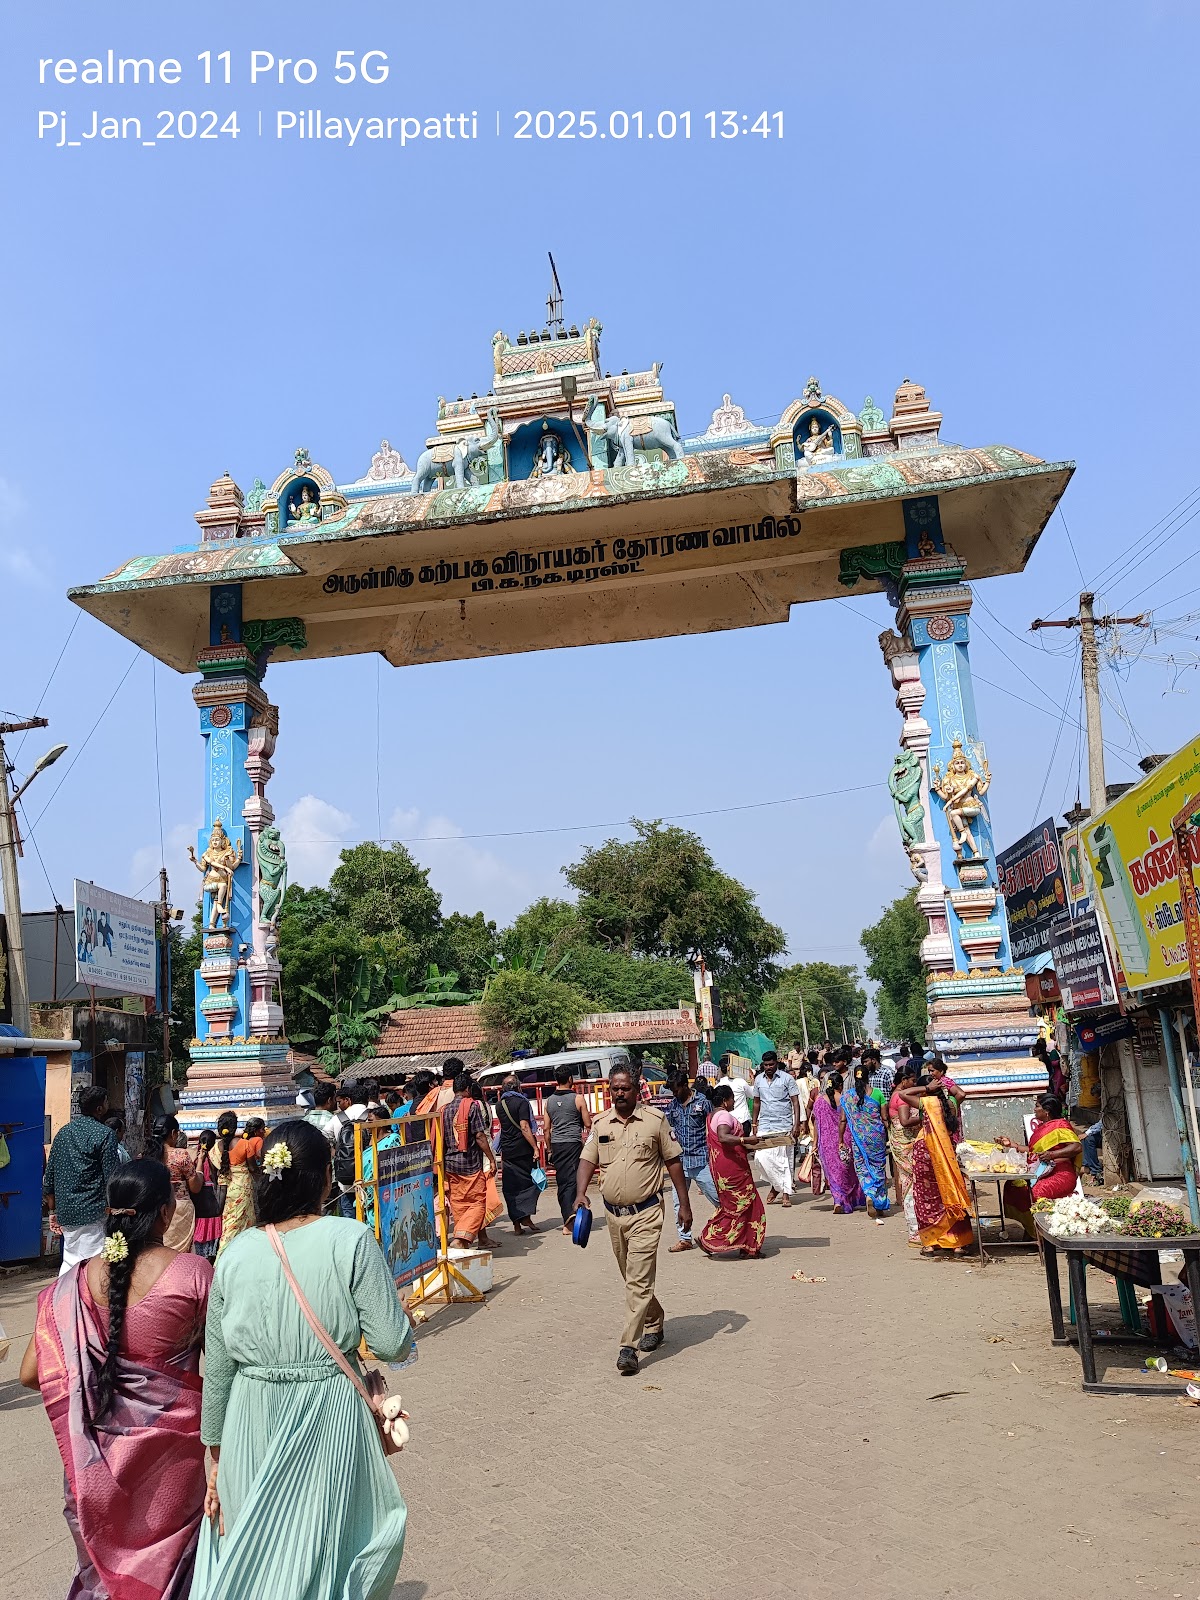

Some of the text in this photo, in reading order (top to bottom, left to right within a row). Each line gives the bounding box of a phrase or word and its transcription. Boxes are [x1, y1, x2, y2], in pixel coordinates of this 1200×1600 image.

[322, 565, 414, 594] அருள்மிகு
[418, 558, 489, 586] கற்பக
[491, 539, 608, 576] விநாயகர்
